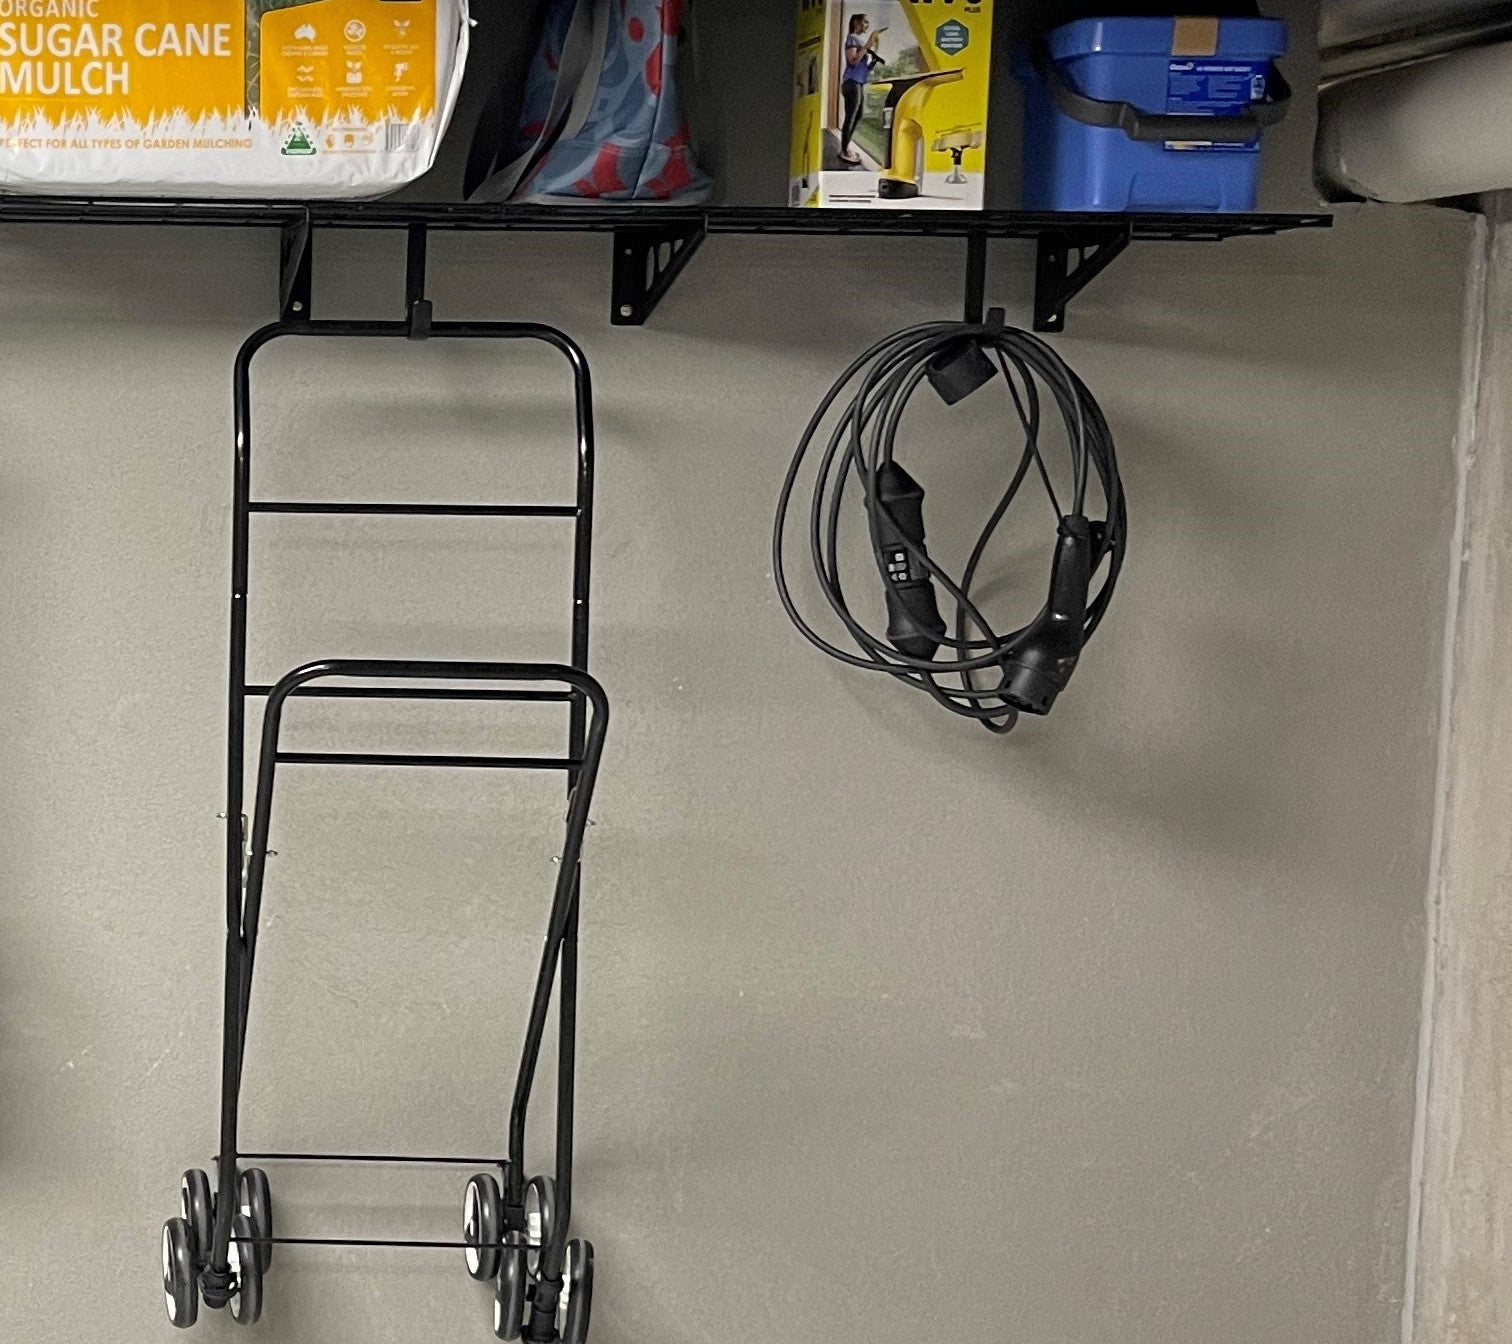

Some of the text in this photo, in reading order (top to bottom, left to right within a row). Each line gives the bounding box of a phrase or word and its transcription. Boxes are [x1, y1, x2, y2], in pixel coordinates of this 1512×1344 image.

[134, 22, 232, 57] CANE
[0, 60, 129, 95] MULCH
[45, 138, 67, 150] FOR
[70, 138, 88, 150] ALL
[92, 138, 122, 150] TYPES
[125, 138, 140, 150] OF
[144, 138, 188, 150] GARDEN
[192, 138, 254, 150] MULCHING
